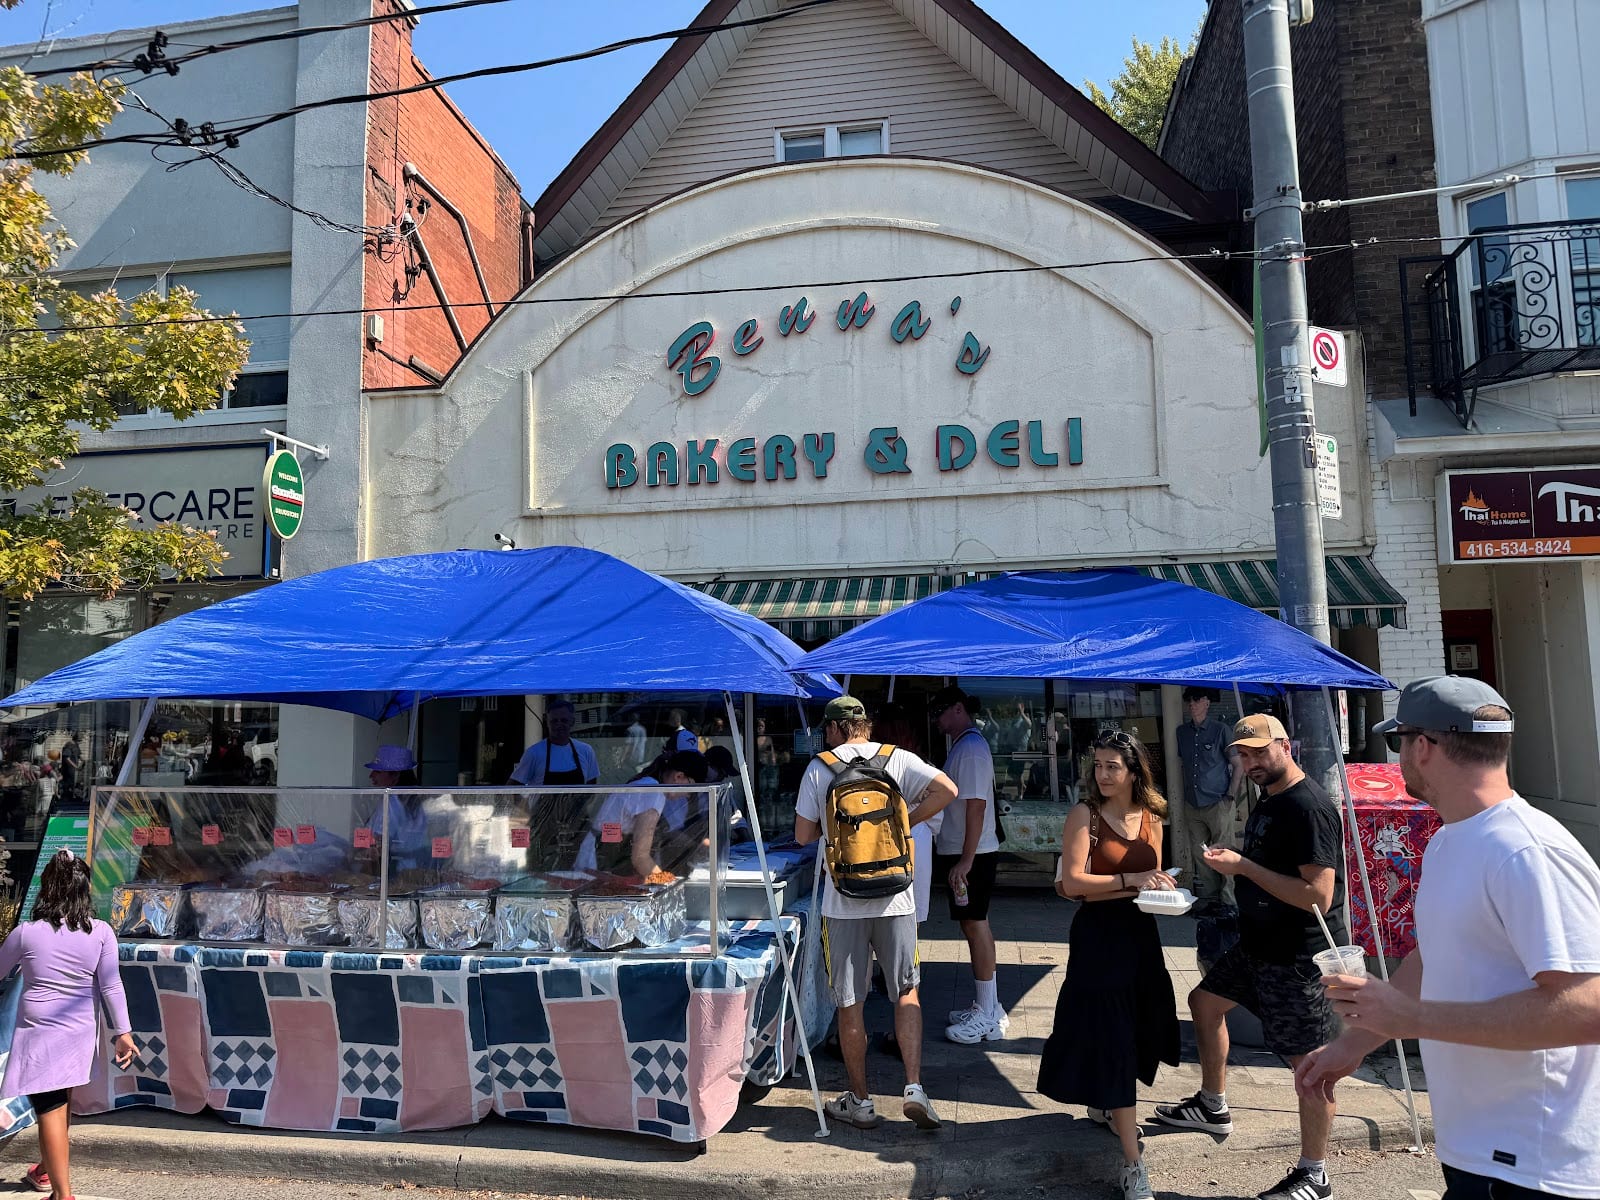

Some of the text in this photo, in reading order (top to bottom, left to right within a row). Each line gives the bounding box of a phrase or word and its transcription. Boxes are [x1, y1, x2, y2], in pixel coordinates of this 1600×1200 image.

[667, 291, 991, 397] Benna's
[604, 416, 1083, 489] BAKERY & DELI
[1459, 505, 1527, 521] Thai Home
[1537, 481, 1600, 523] Th
[1466, 540, 1571, 557] 416-534-8424
[1101, 721, 1119, 729] PASS
